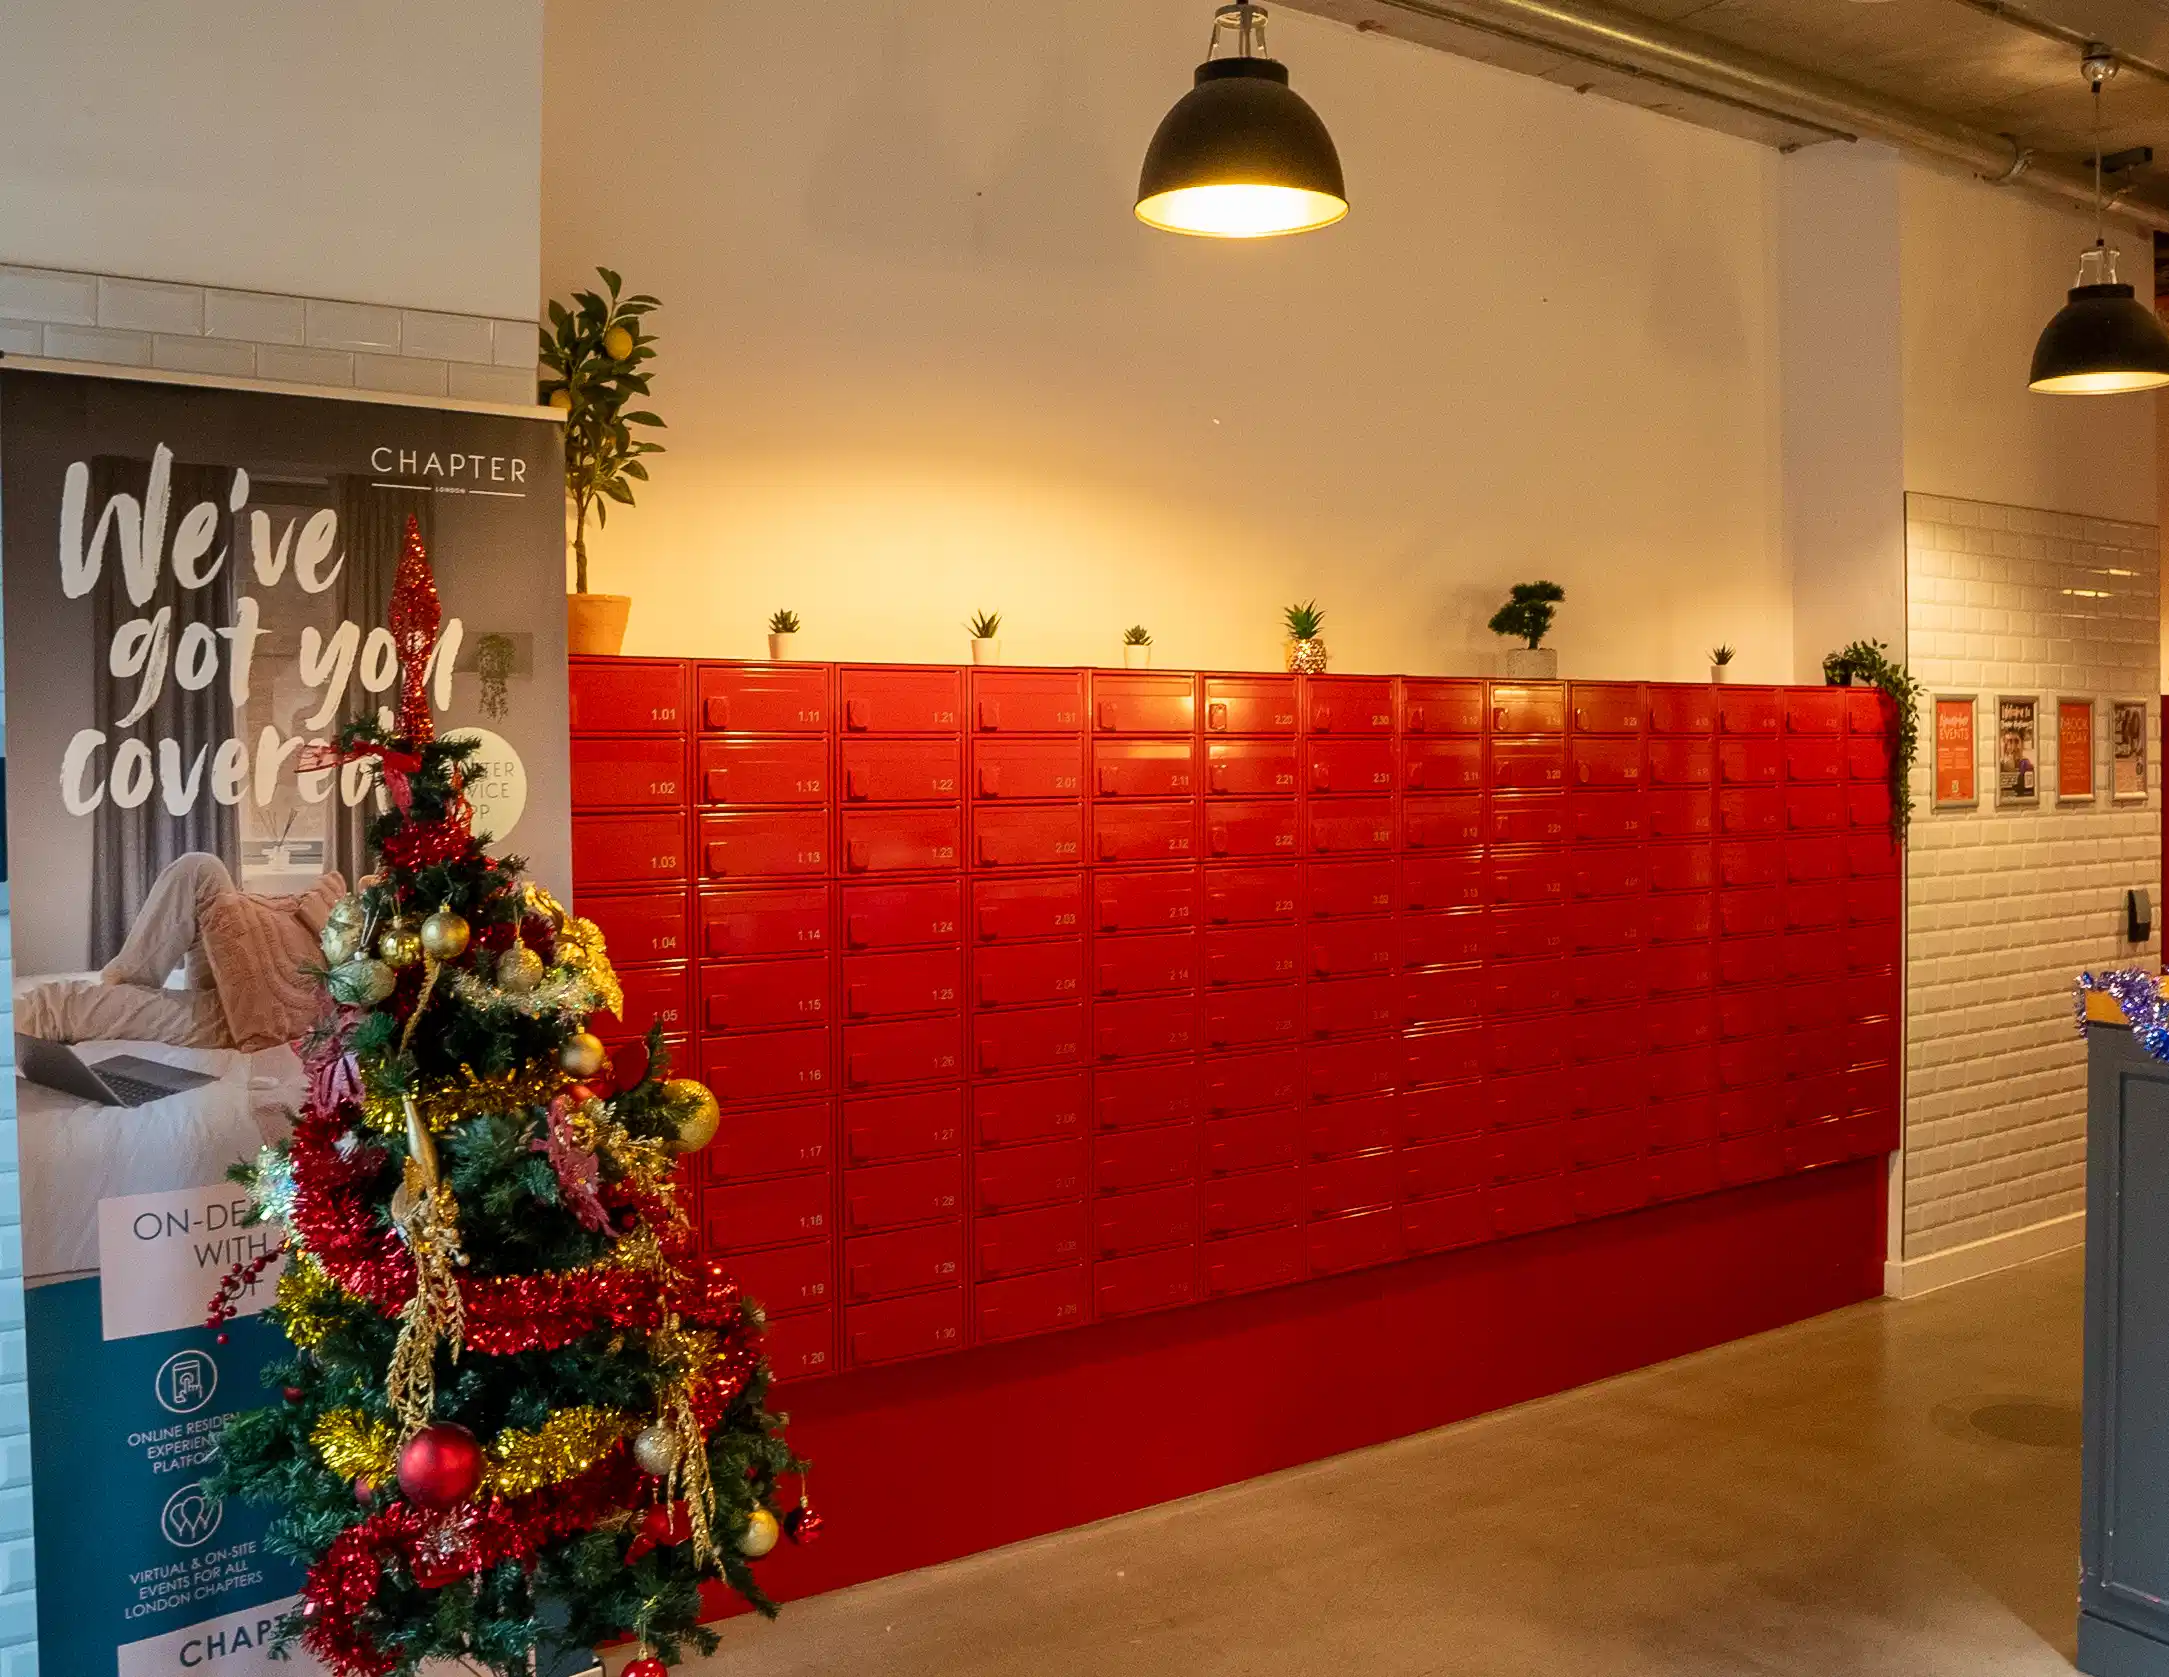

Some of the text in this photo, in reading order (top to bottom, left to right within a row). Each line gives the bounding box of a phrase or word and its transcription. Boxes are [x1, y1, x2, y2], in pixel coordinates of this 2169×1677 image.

[371, 447, 527, 483] CHAPTER
[60, 442, 346, 607] We've
[110, 596, 272, 728] got
[652, 709, 675, 720] 1.01
[799, 711, 819, 722] 1.11
[934, 712, 954, 723] 1.21
[650, 782, 675, 794] 1.02
[796, 780, 820, 792] 1.12
[933, 779, 953, 790] 1.22
[798, 852, 820, 863] 1.13
[932, 847, 952, 858] 1.23
[651, 856, 676, 868] 1.03
[933, 922, 953, 932] 1.24
[798, 929, 820, 940] 1.14
[652, 937, 676, 949] 1.04
[932, 989, 953, 1000] 1.25
[799, 999, 821, 1010] 1.15
[653, 1010, 678, 1021] 1.05
[799, 1070, 821, 1080] 1.16
[800, 1146, 822, 1158] 1.17
[133, 1199, 247, 1240] ON-DE
[193, 1232, 267, 1268] WITH
[127, 1412, 240, 1447] ONLINE RESIDEN
[147, 1436, 213, 1459] EXPERIEN
[129, 1541, 257, 1584] VIRTUAL & ON-SITE
[139, 1559, 249, 1601] EVENTS FOR ALL
[124, 1571, 263, 1619] LONDON CHAPTERS
[180, 1617, 280, 1667] CHAP
